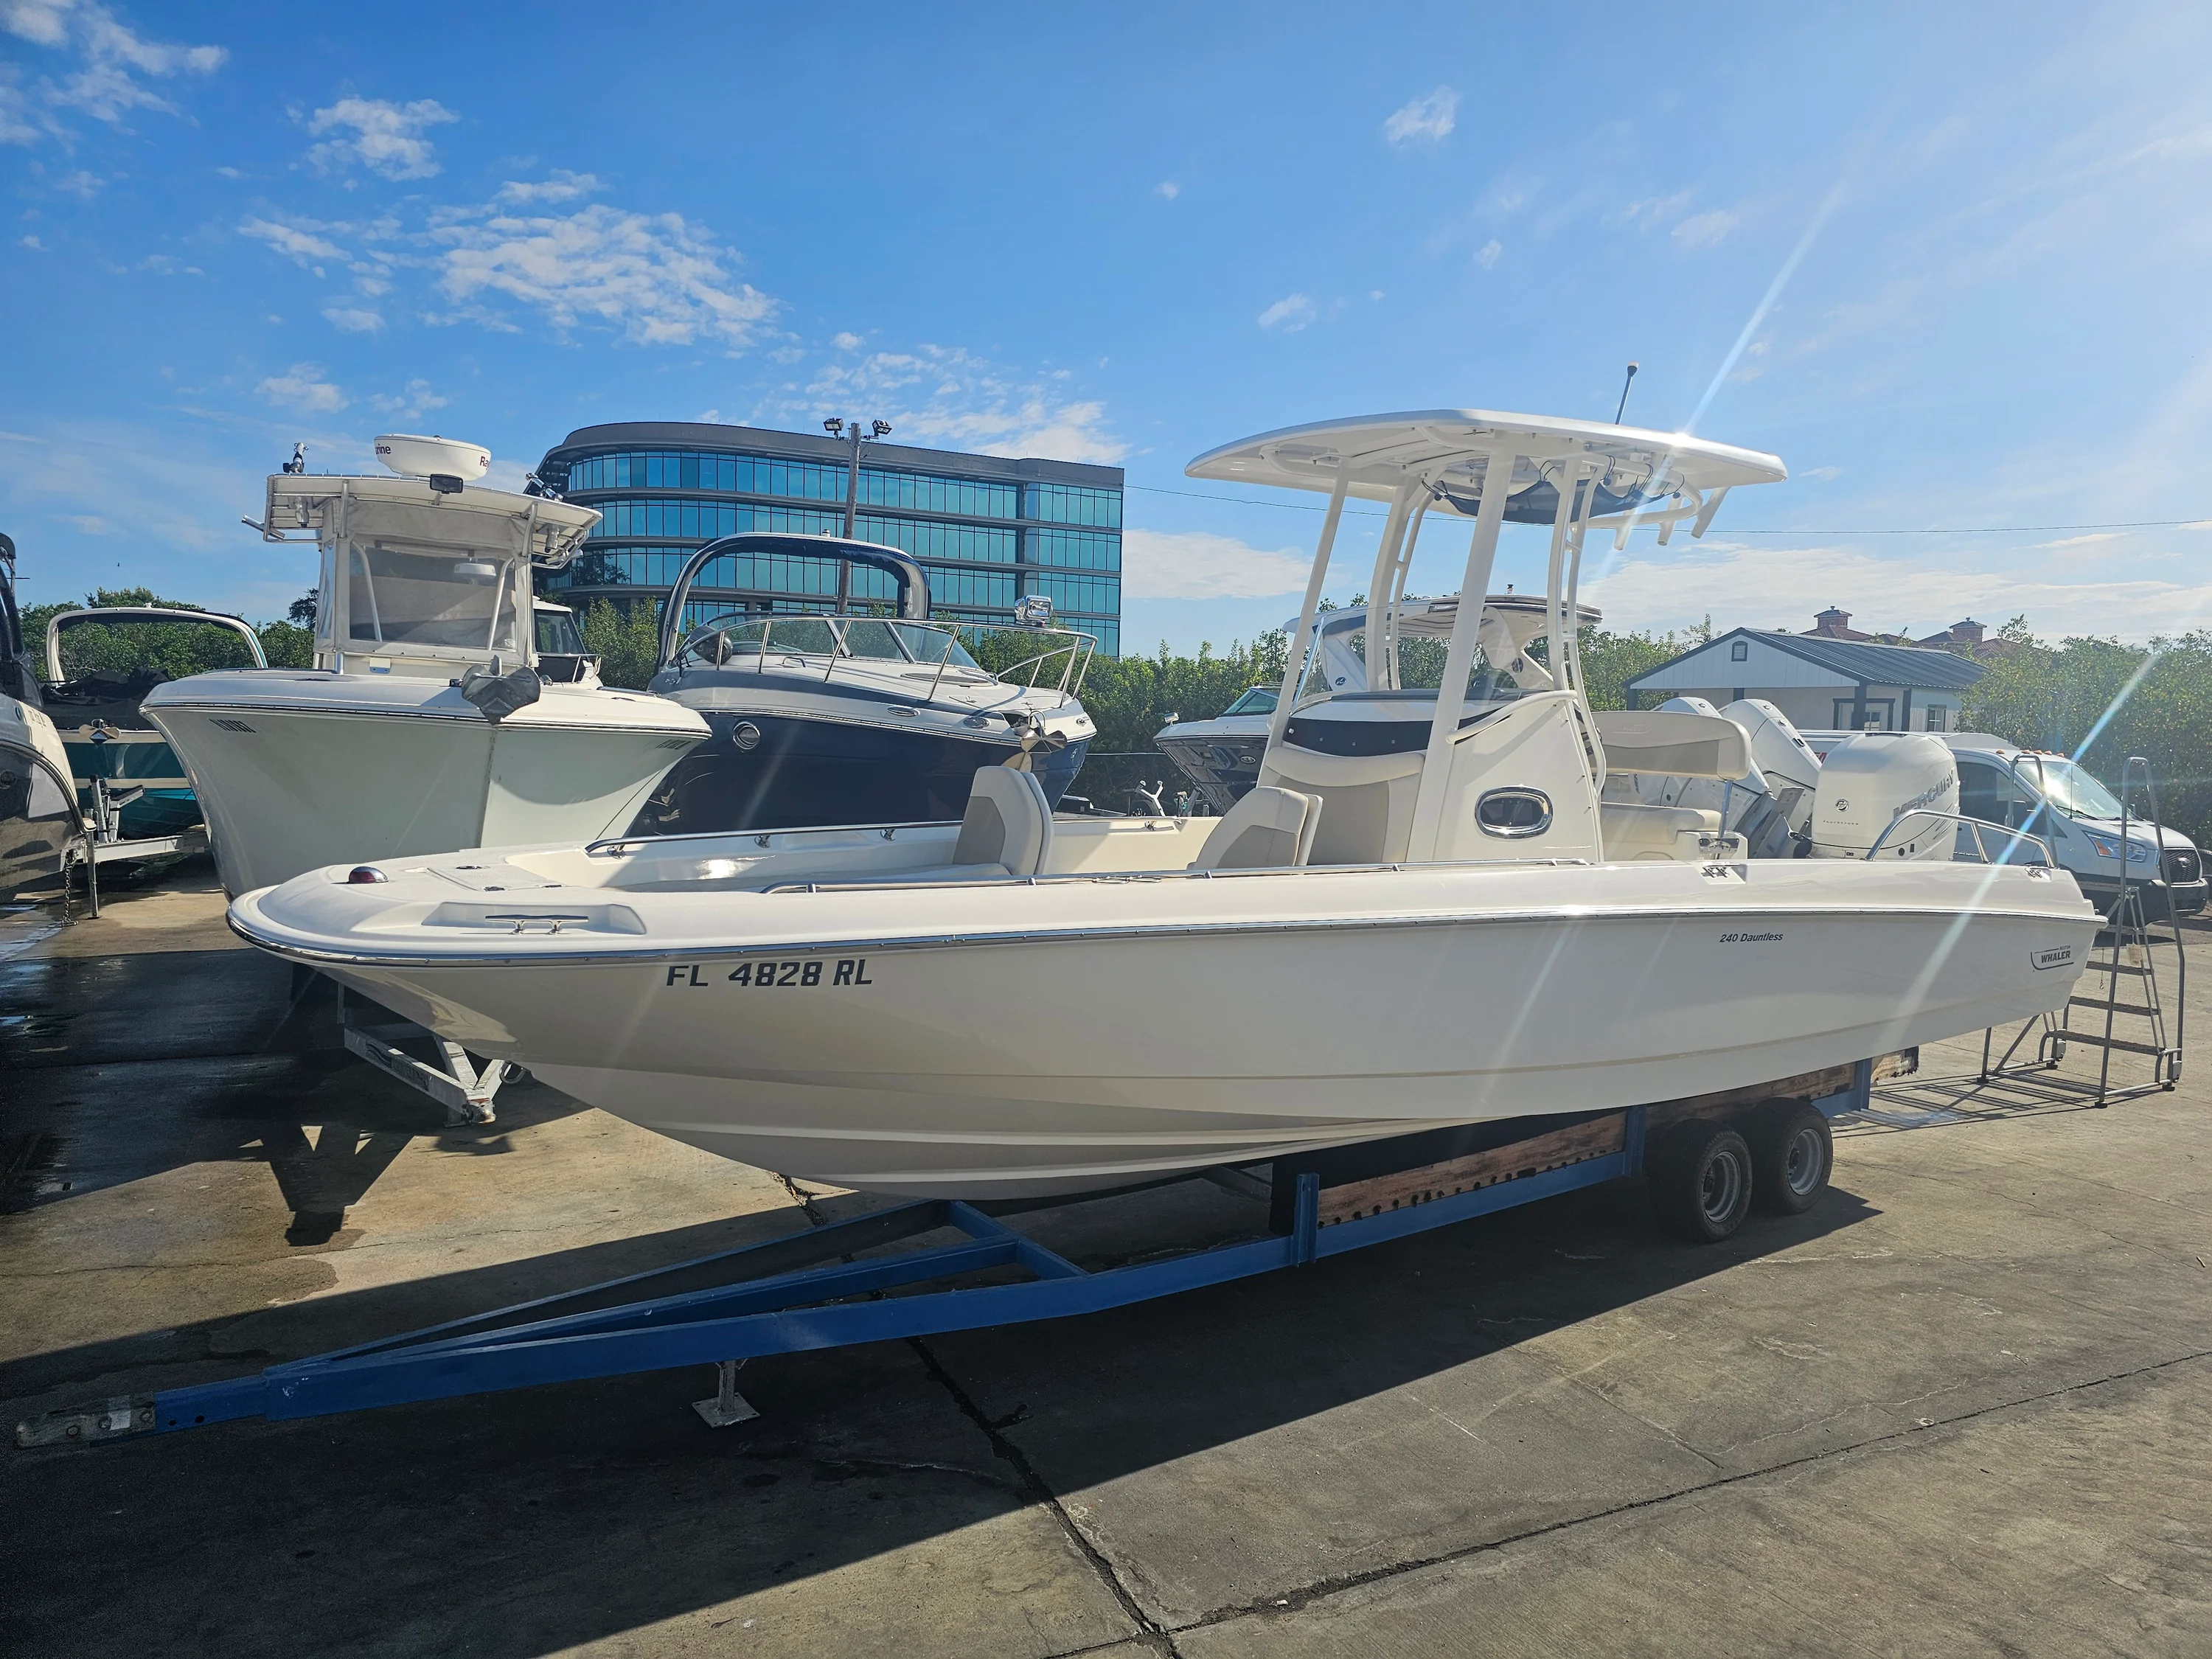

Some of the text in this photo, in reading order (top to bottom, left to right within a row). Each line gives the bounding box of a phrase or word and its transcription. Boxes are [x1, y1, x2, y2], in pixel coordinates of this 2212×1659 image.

[1719, 932, 1784, 942] 240 Dauntless
[2041, 950, 2070, 963] WHALER
[667, 959, 872, 987] FL 4828 RL
